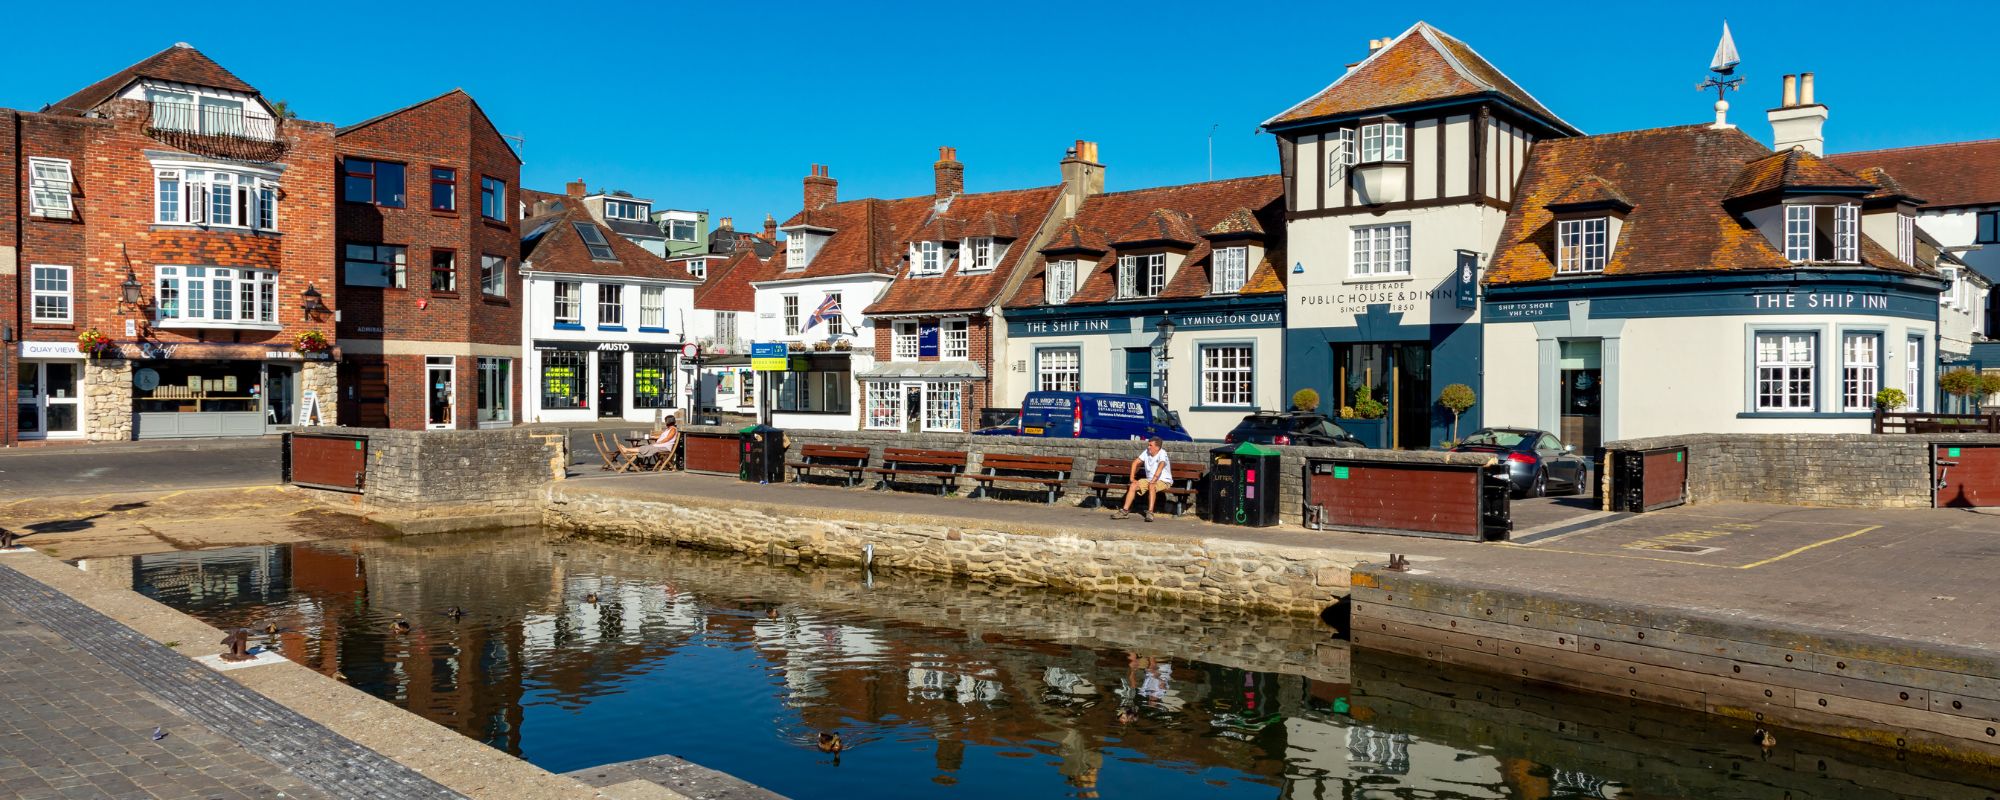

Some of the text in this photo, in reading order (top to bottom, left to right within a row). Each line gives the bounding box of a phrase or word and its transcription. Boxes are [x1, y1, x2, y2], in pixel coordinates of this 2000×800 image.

[1355, 282, 1405, 291] FREE TRADE
[1301, 294, 1345, 305] PUBLIC
[1348, 292, 1393, 303] HOUSE
[1397, 291, 1405, 301] &
[1753, 293, 1887, 309] THE SHIP INN
[1340, 305, 1366, 313] SINCE
[1183, 312, 1280, 325] LYMINGTON QUAY
[1026, 319, 1109, 333] THE SHIP INN
[141, 342, 156, 359] &
[597, 342, 630, 351] MUSTO
[1108, 400, 1126, 409] WRIGHT
